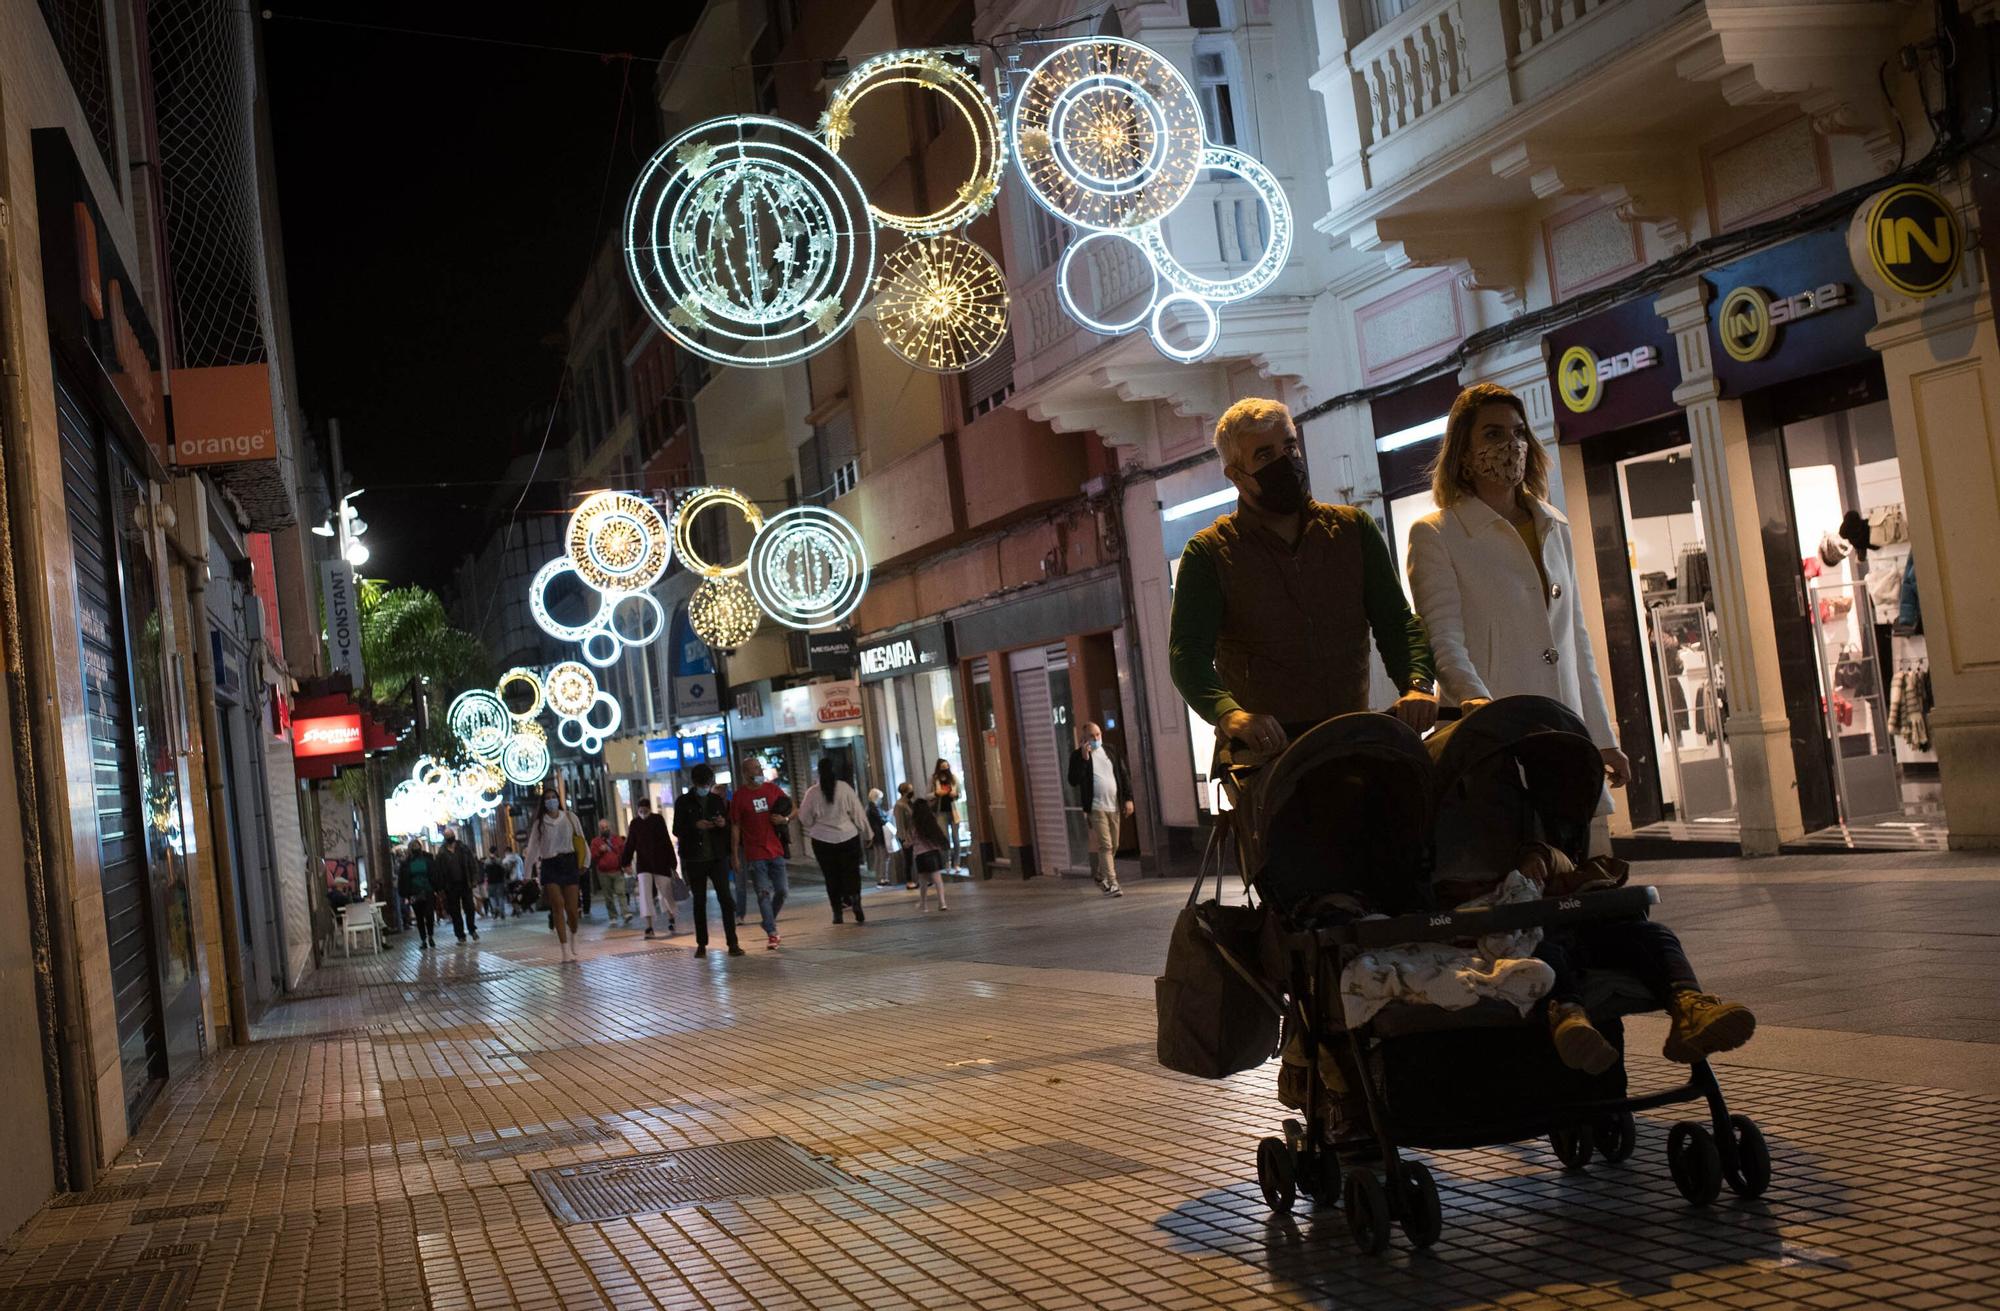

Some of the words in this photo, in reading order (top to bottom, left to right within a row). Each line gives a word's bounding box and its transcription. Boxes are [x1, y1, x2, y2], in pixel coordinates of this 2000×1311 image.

[1880, 216, 1952, 264] IN
[181, 434, 265, 456] orange
[331, 570, 351, 649] CONSTANT
[859, 639, 917, 675] MESAIRA
[1558, 897, 1582, 911] Joie
[1429, 914, 1453, 927] Joie
